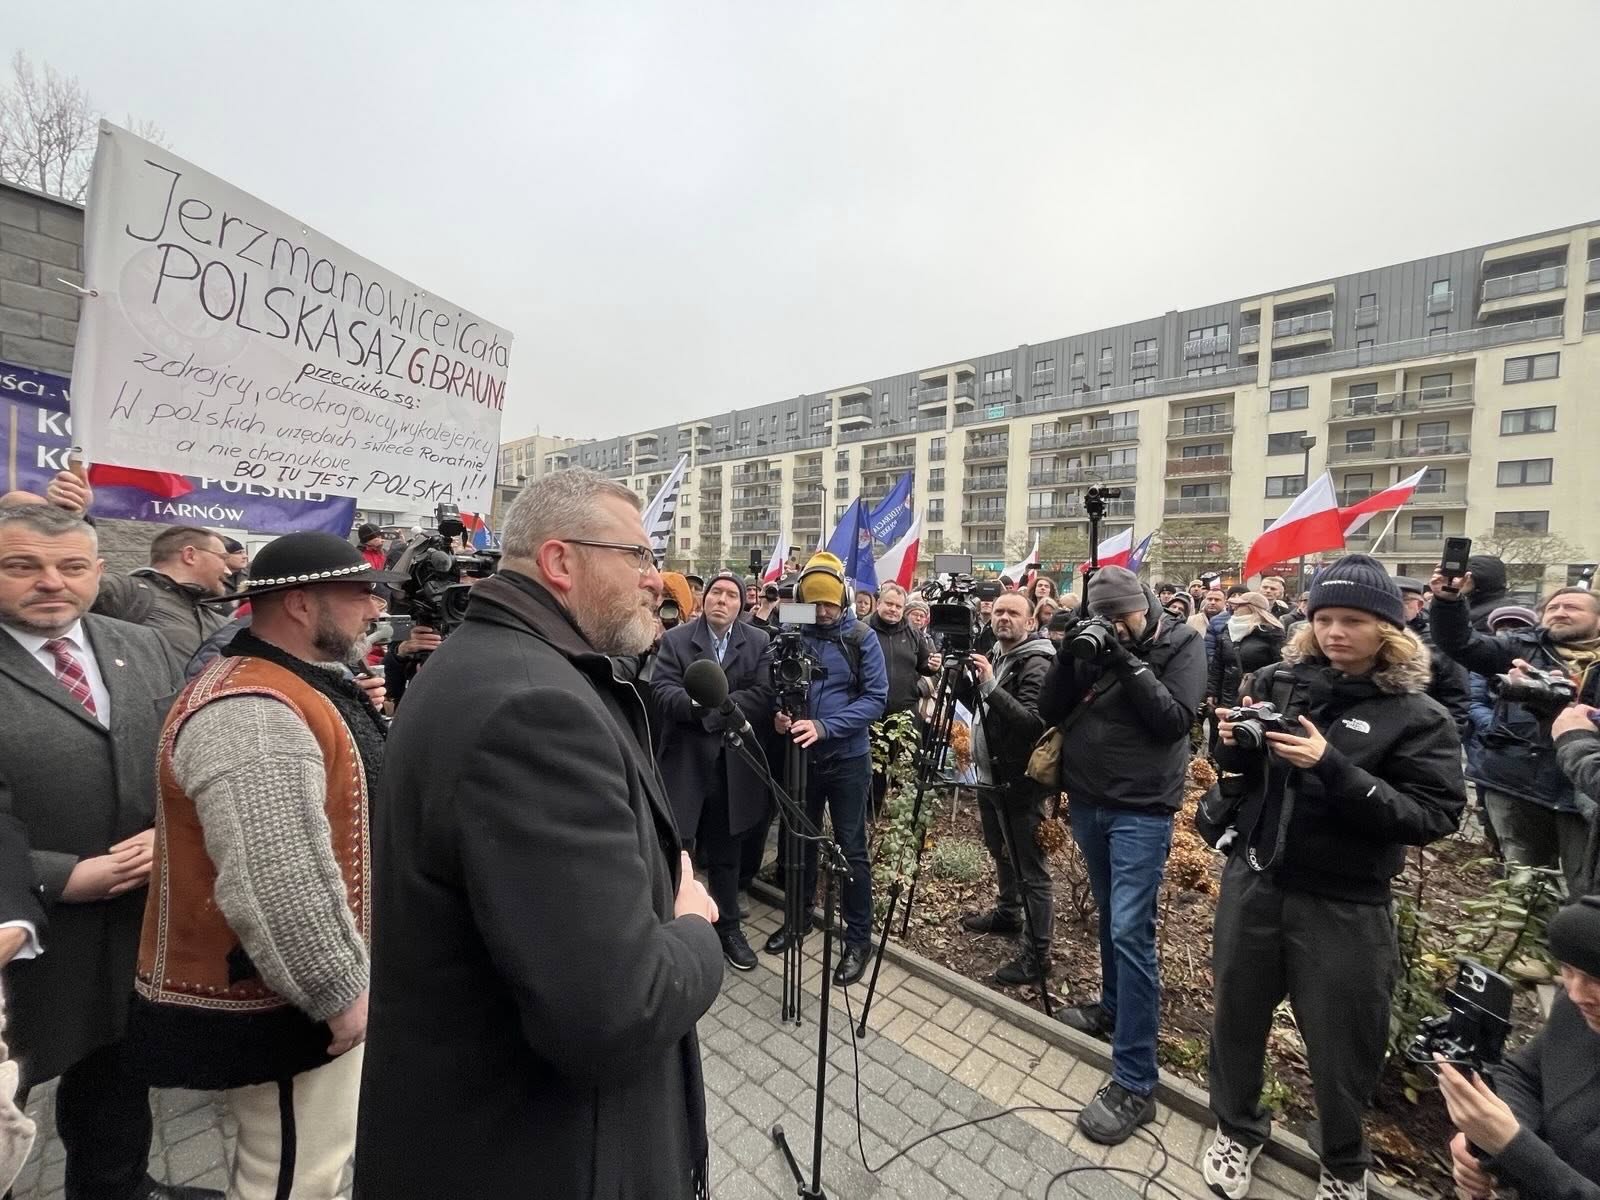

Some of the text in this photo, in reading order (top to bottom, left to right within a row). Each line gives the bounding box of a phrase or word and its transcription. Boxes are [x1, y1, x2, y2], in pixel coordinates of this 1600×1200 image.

[125, 159, 450, 347] Jerzmanowice
[0, 374, 45, 396] ŚCI
[176, 439, 197, 453] a
[207, 442, 242, 459] nie
[419, 446, 484, 472] Roratnie
[234, 460, 266, 479] BO
[279, 466, 302, 481] TU
[304, 470, 359, 489] JEST
[150, 500, 244, 522] TARNÓW
